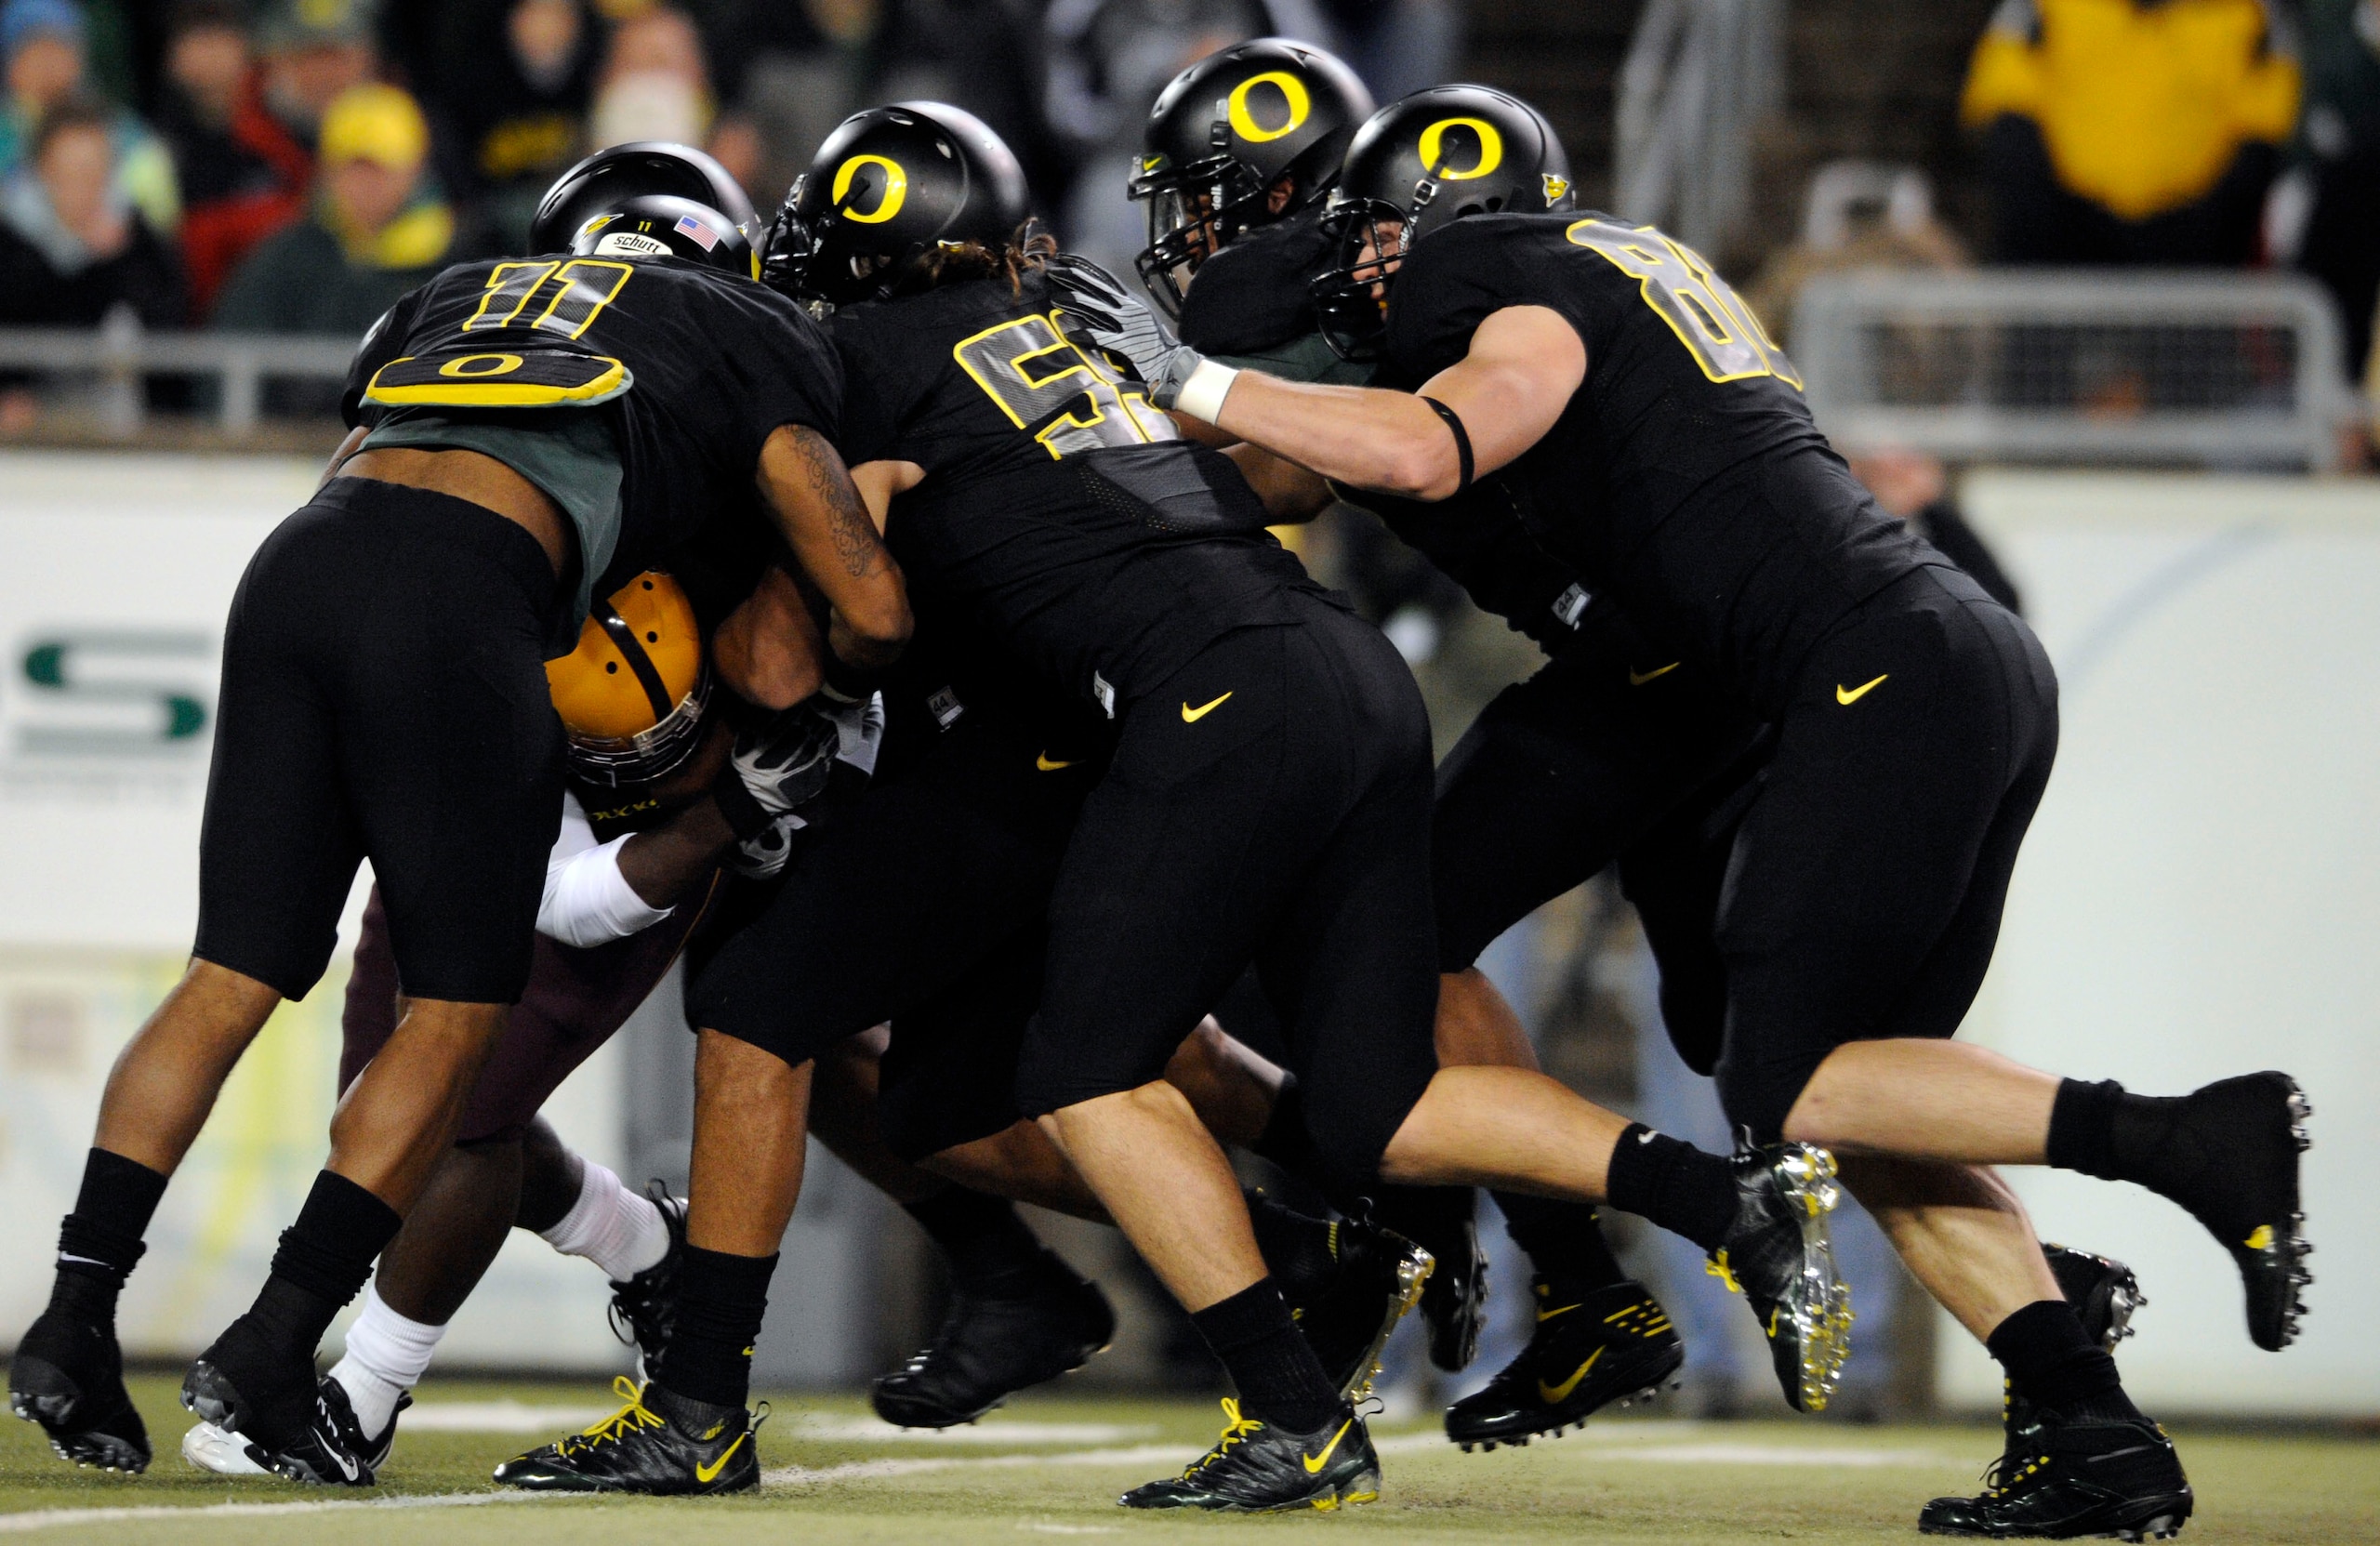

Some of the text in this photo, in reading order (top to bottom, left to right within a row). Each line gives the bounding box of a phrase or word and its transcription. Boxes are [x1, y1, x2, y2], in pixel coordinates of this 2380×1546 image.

[1227, 71, 1311, 142] O
[1419, 117, 1502, 180] O
[832, 154, 907, 223] O
[614, 234, 661, 254] schutt
[638, 221, 653, 232] 11
[462, 259, 634, 340] 11
